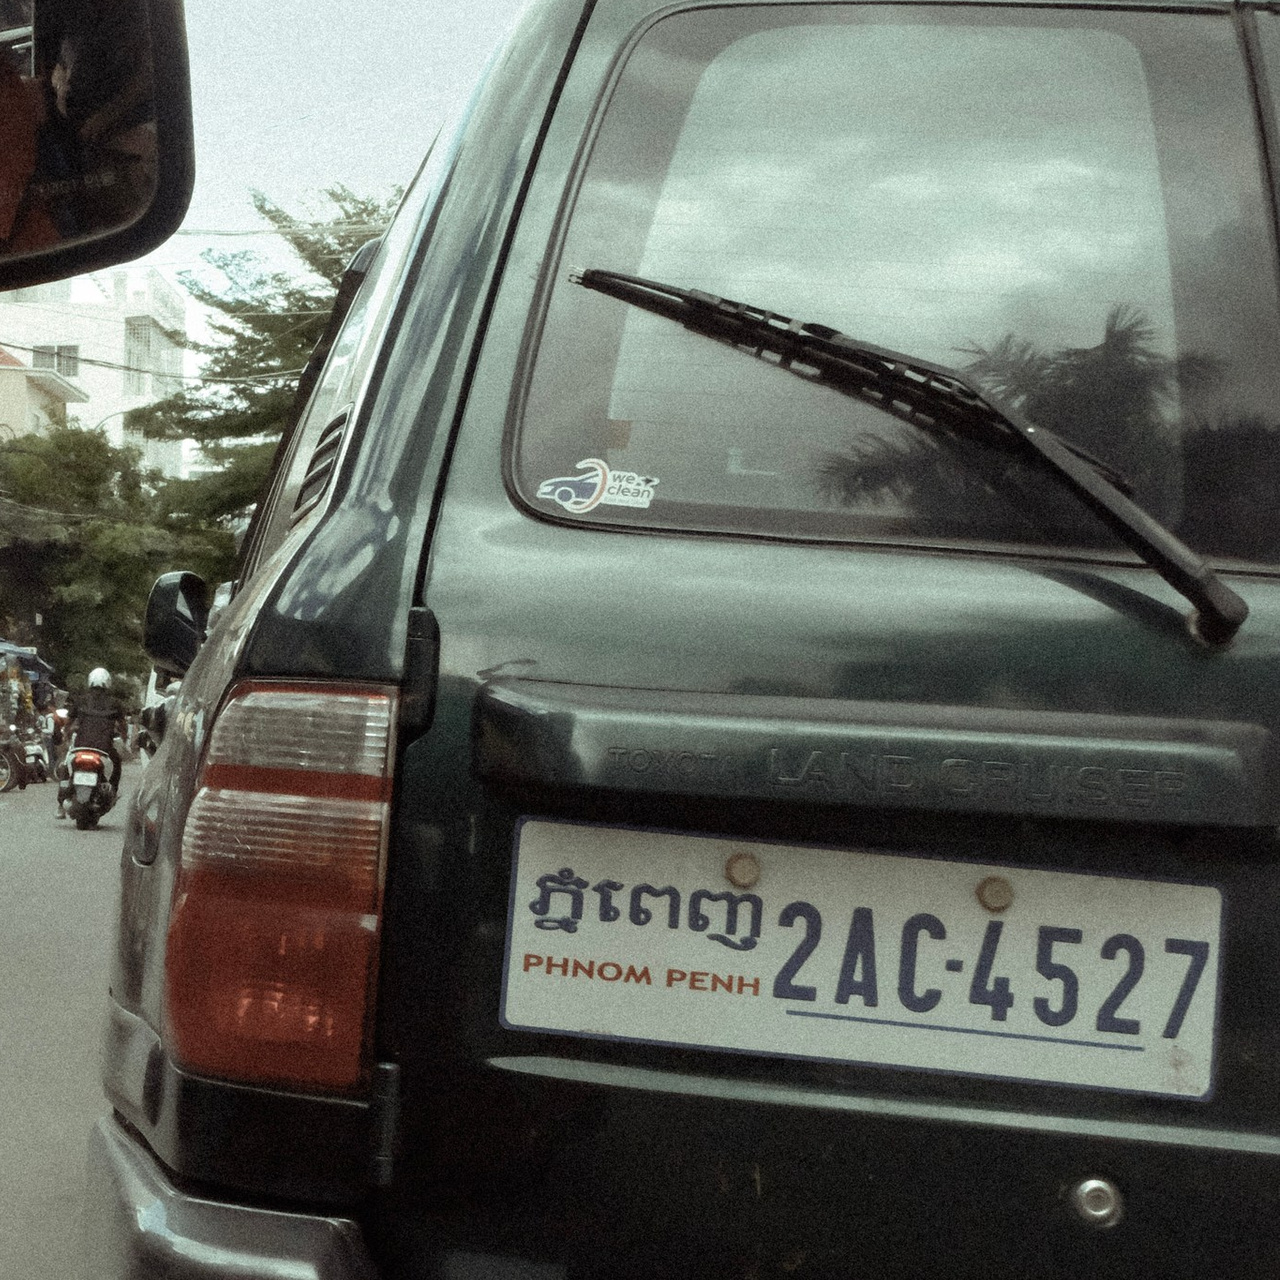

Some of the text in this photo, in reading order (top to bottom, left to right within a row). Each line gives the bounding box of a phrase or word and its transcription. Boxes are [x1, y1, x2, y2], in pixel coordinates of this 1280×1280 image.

[607, 484, 652, 499] clean
[612, 472, 635, 485] we
[608, 744, 1191, 808] TOYOTA LAND CRUISER
[529, 867, 764, 951] ភ្នំពេញ
[522, 953, 761, 997] PHNOM PENH
[772, 902, 1210, 1040] 2AC-4527
